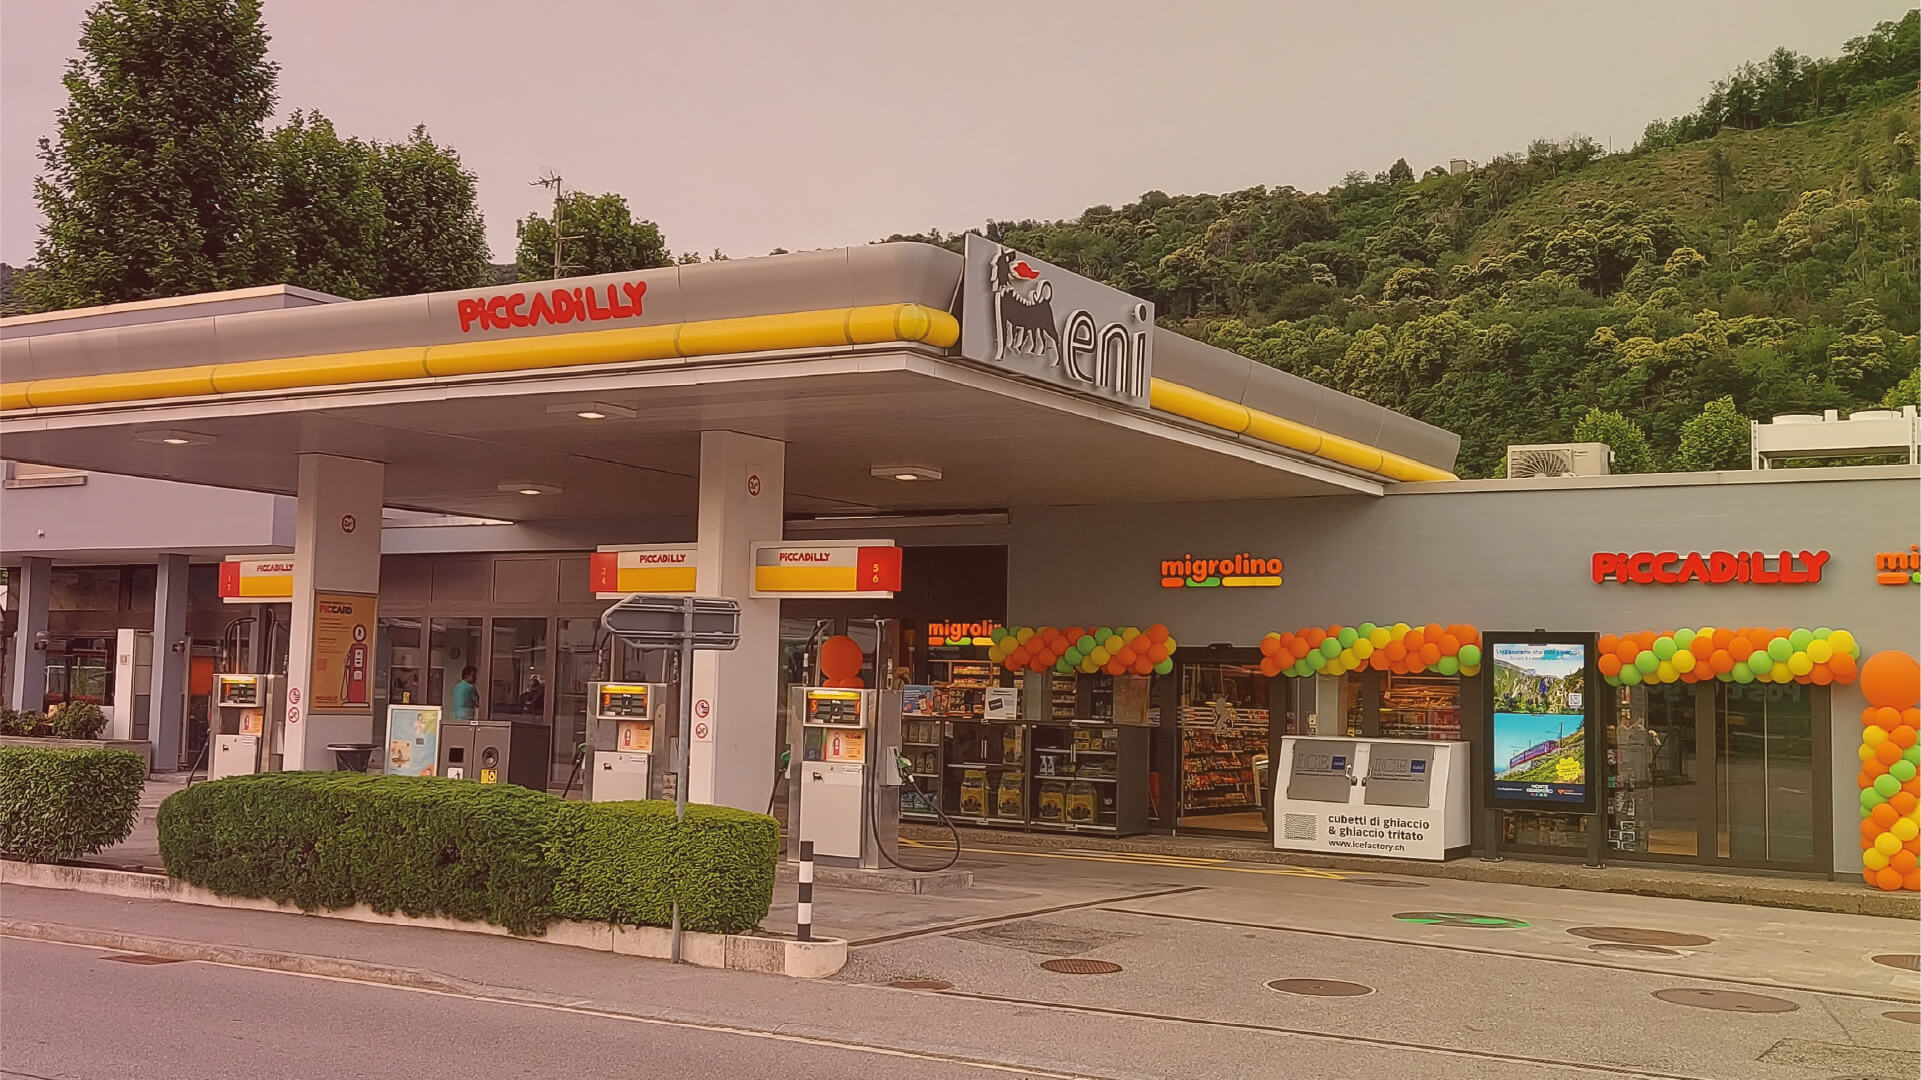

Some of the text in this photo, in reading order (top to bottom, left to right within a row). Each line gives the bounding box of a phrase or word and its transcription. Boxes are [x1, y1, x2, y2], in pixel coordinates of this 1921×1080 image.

[1063, 303, 1147, 397] eni
[872, 563, 879, 573] 5
[1161, 552, 1283, 582] migrolino
[872, 575, 879, 583] 6
[1328, 815, 1430, 829] cubetti di ghiaccio
[1328, 826, 1424, 841] & ghiaccio tritato
[1328, 840, 1405, 852] www.icefactory.ch
